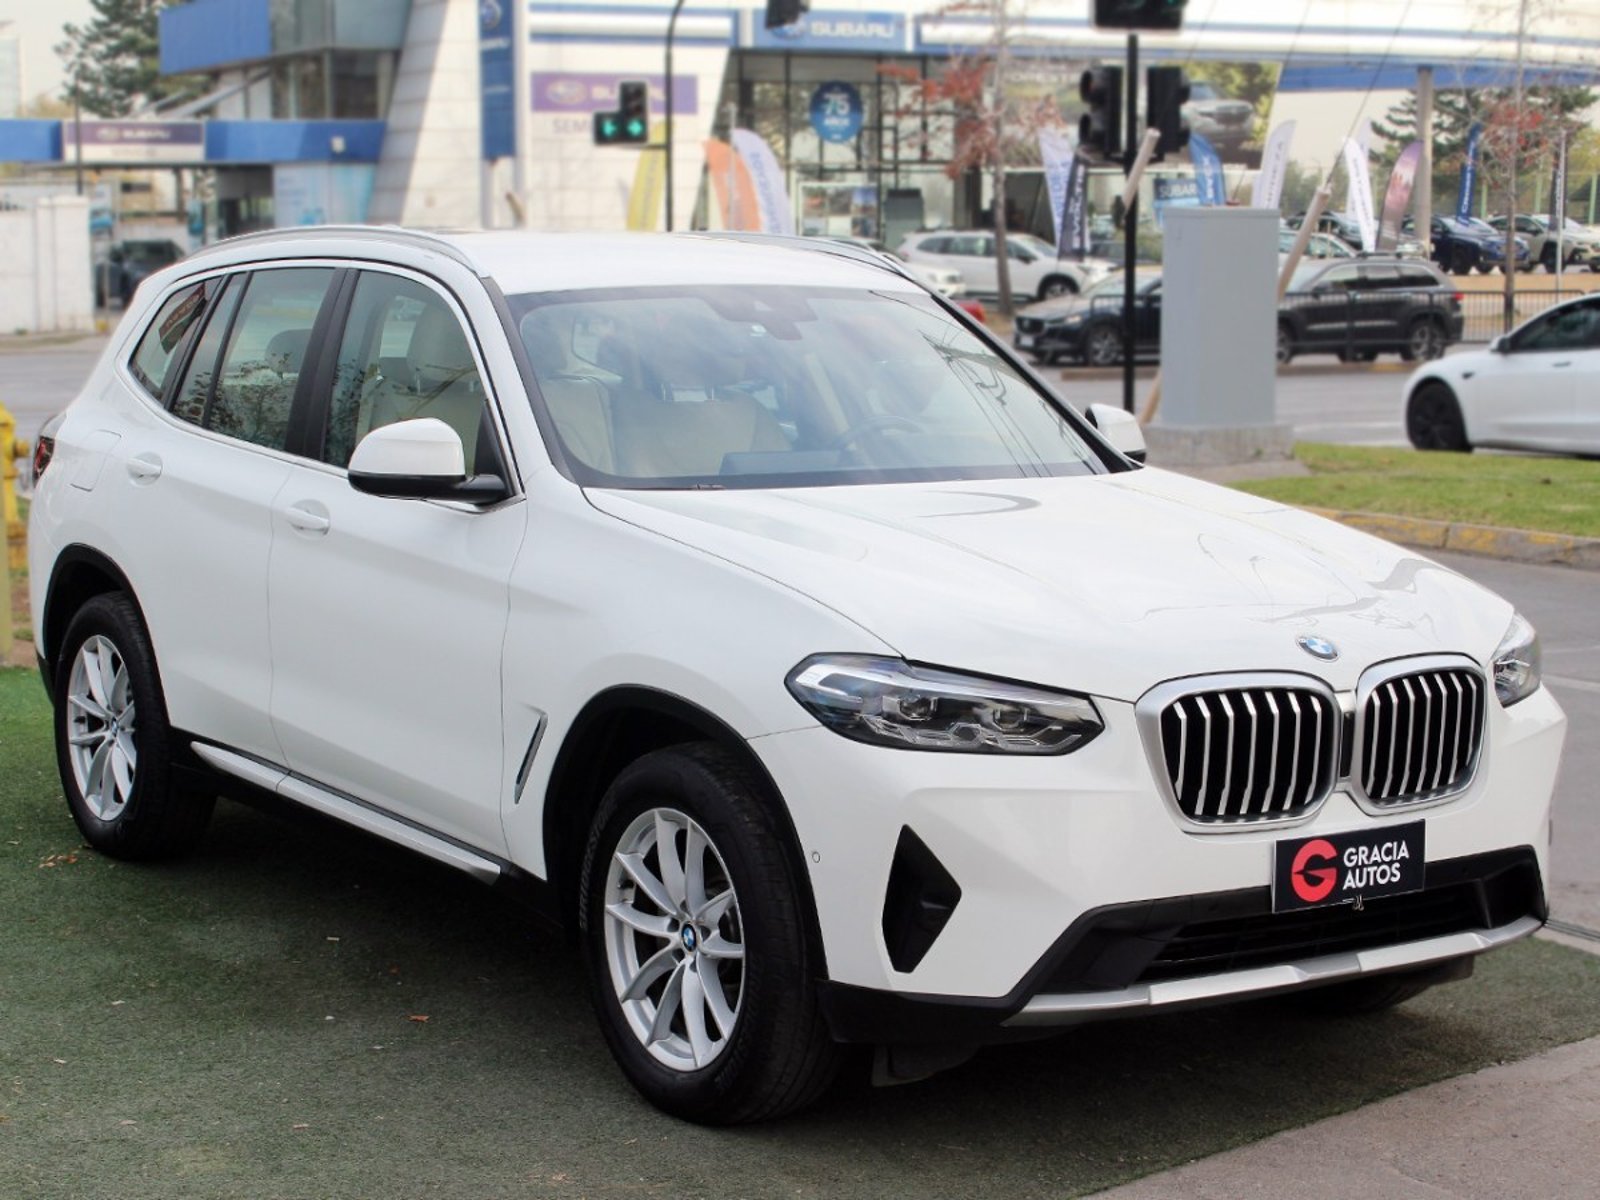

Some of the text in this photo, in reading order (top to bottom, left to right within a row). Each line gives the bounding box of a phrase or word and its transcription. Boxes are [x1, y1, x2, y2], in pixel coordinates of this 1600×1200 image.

[810, 20, 895, 39] SUBARU
[1158, 182, 1198, 197] SUBAR
[1343, 840, 1409, 867] GRACIA
[1342, 862, 1401, 890] AUTOS
